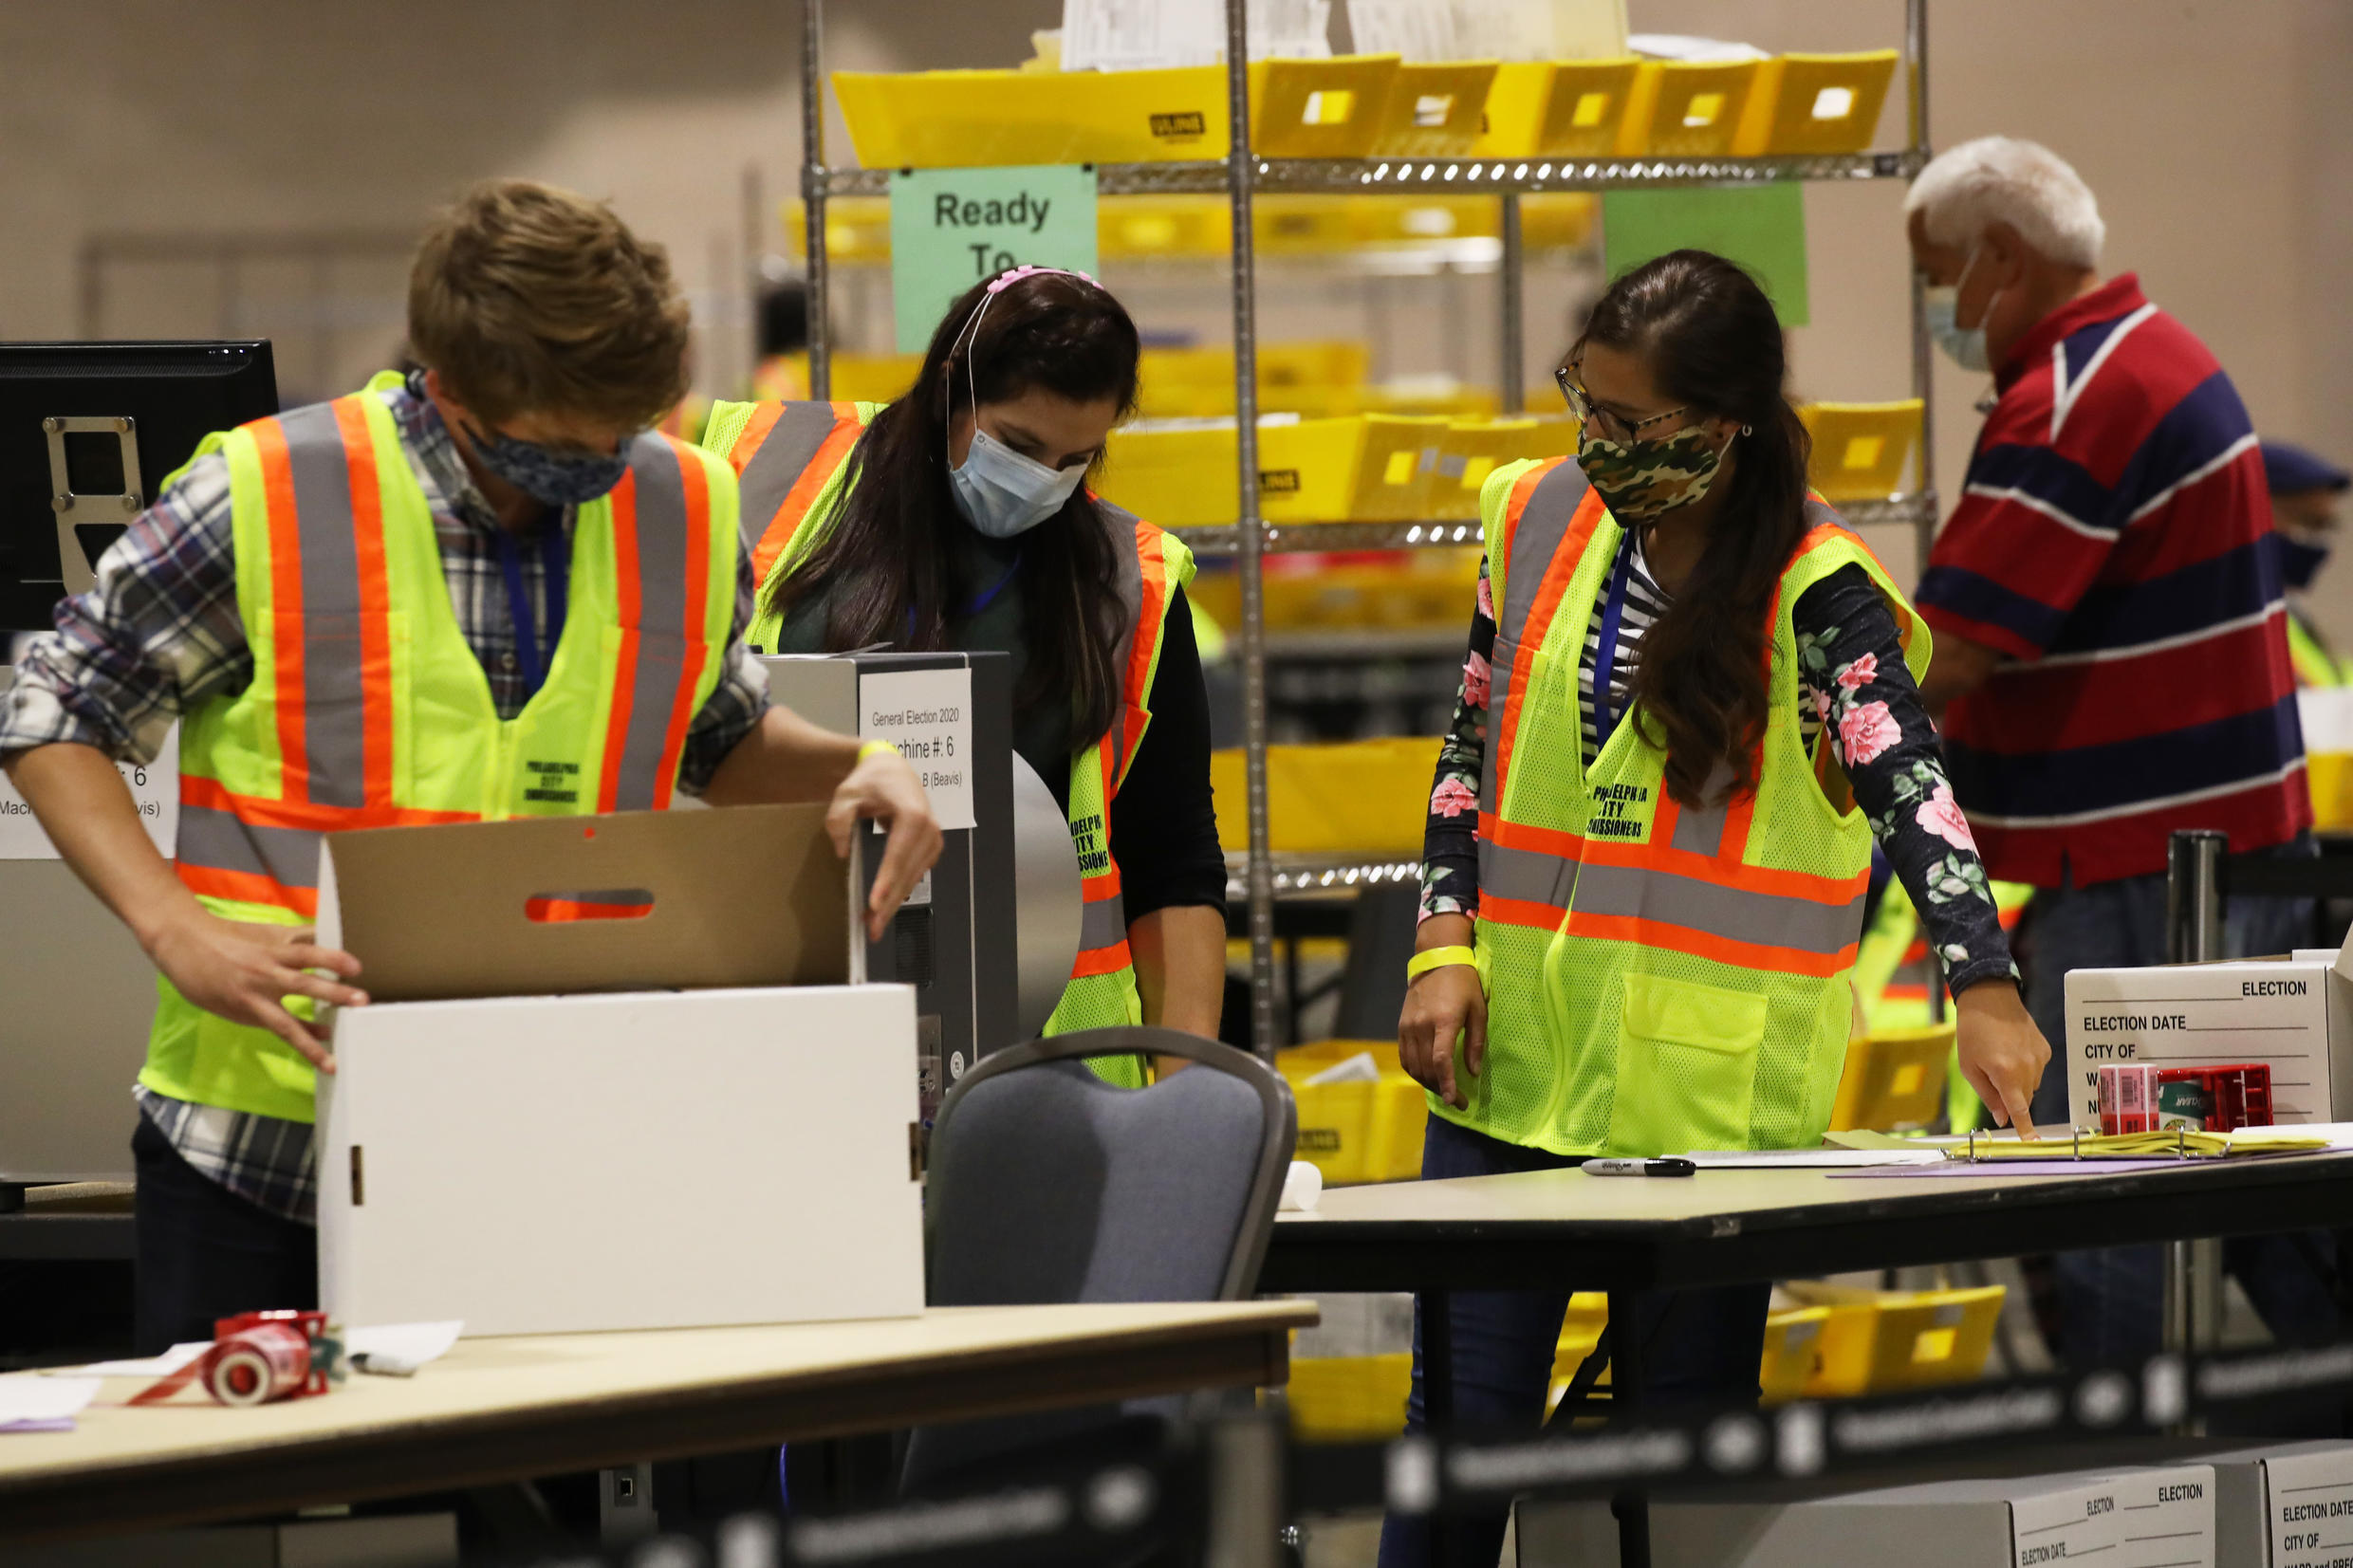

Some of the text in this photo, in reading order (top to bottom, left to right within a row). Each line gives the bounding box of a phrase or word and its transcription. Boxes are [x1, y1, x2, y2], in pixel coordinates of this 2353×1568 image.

[936, 192, 1049, 232] Ready
[969, 244, 1015, 276] To
[873, 708, 959, 727] General Election 2020
[933, 736, 944, 757] #:
[946, 735, 954, 757] 6
[134, 766, 147, 786] 6
[922, 769, 962, 790] B (Beavis)
[1602, 801, 1624, 818] ITY
[1074, 834, 1094, 854] ITY
[2242, 981, 2307, 996] ELECTION
[2084, 1015, 2186, 1031] ELECTION DATE
[2084, 1043, 2136, 1059] CITY OF
[2158, 1484, 2203, 1503] ELECTION
[2087, 1496, 2114, 1516] ELECTION
[2283, 1500, 2353, 1522] ELECTION DATE
[2285, 1533, 2319, 1552] CITY OF
[2022, 1541, 2066, 1566] ELECTION DATE
